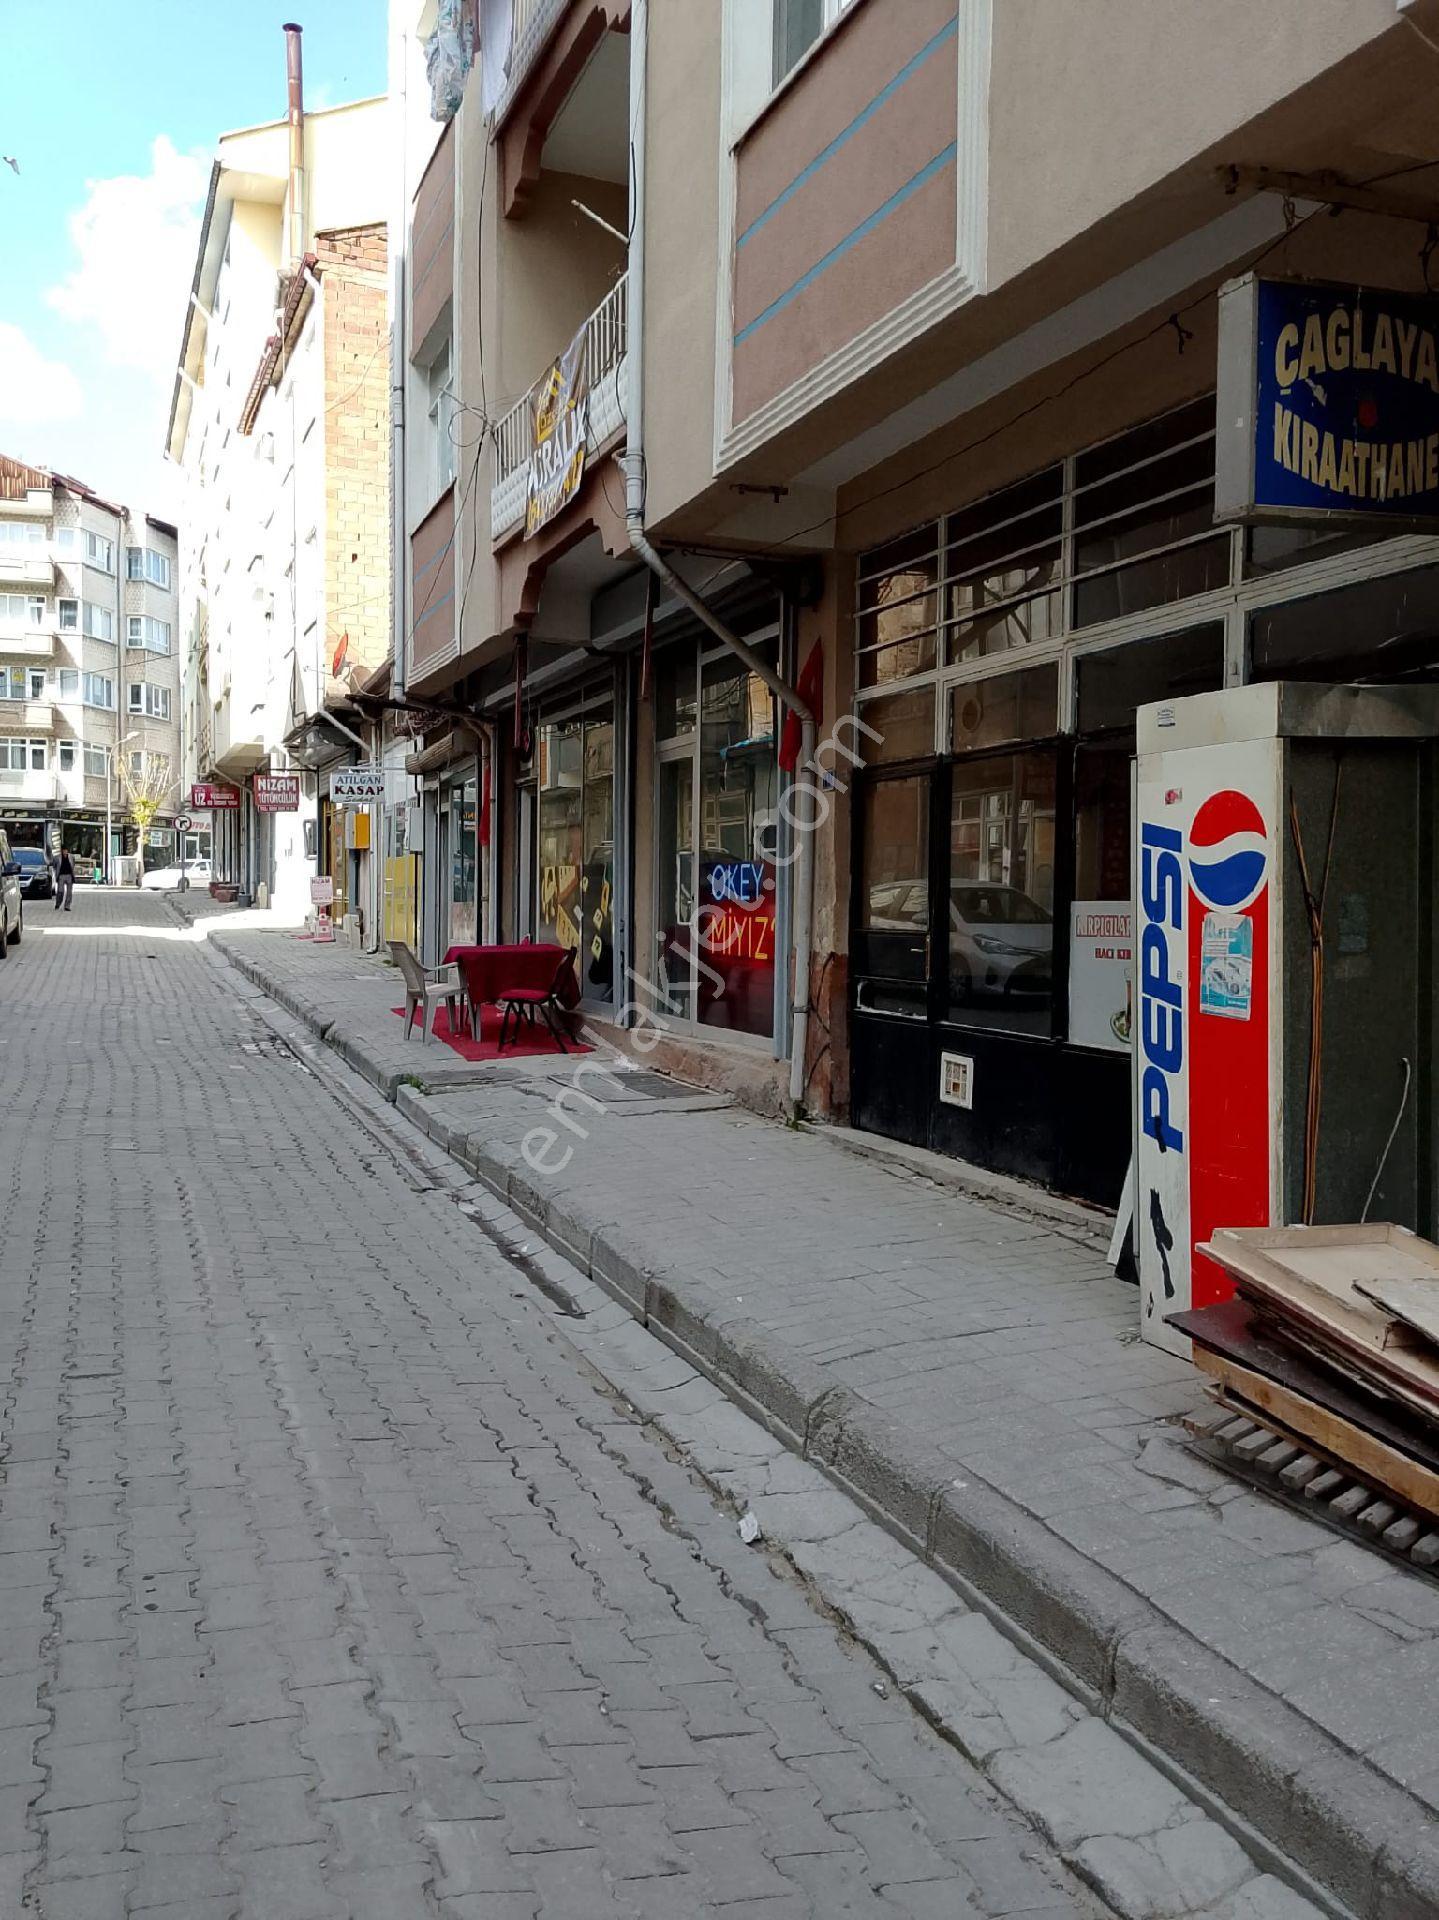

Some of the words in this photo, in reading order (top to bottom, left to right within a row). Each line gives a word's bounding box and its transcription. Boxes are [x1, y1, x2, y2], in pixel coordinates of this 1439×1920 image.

[1274, 402, 1439, 501] KIRAATHANE
[334, 785, 385, 796] KASAP
[336, 775, 381, 785] ATILGAN
[711, 863, 765, 901] OKEY
[1142, 822, 1183, 1153] PEPSI
